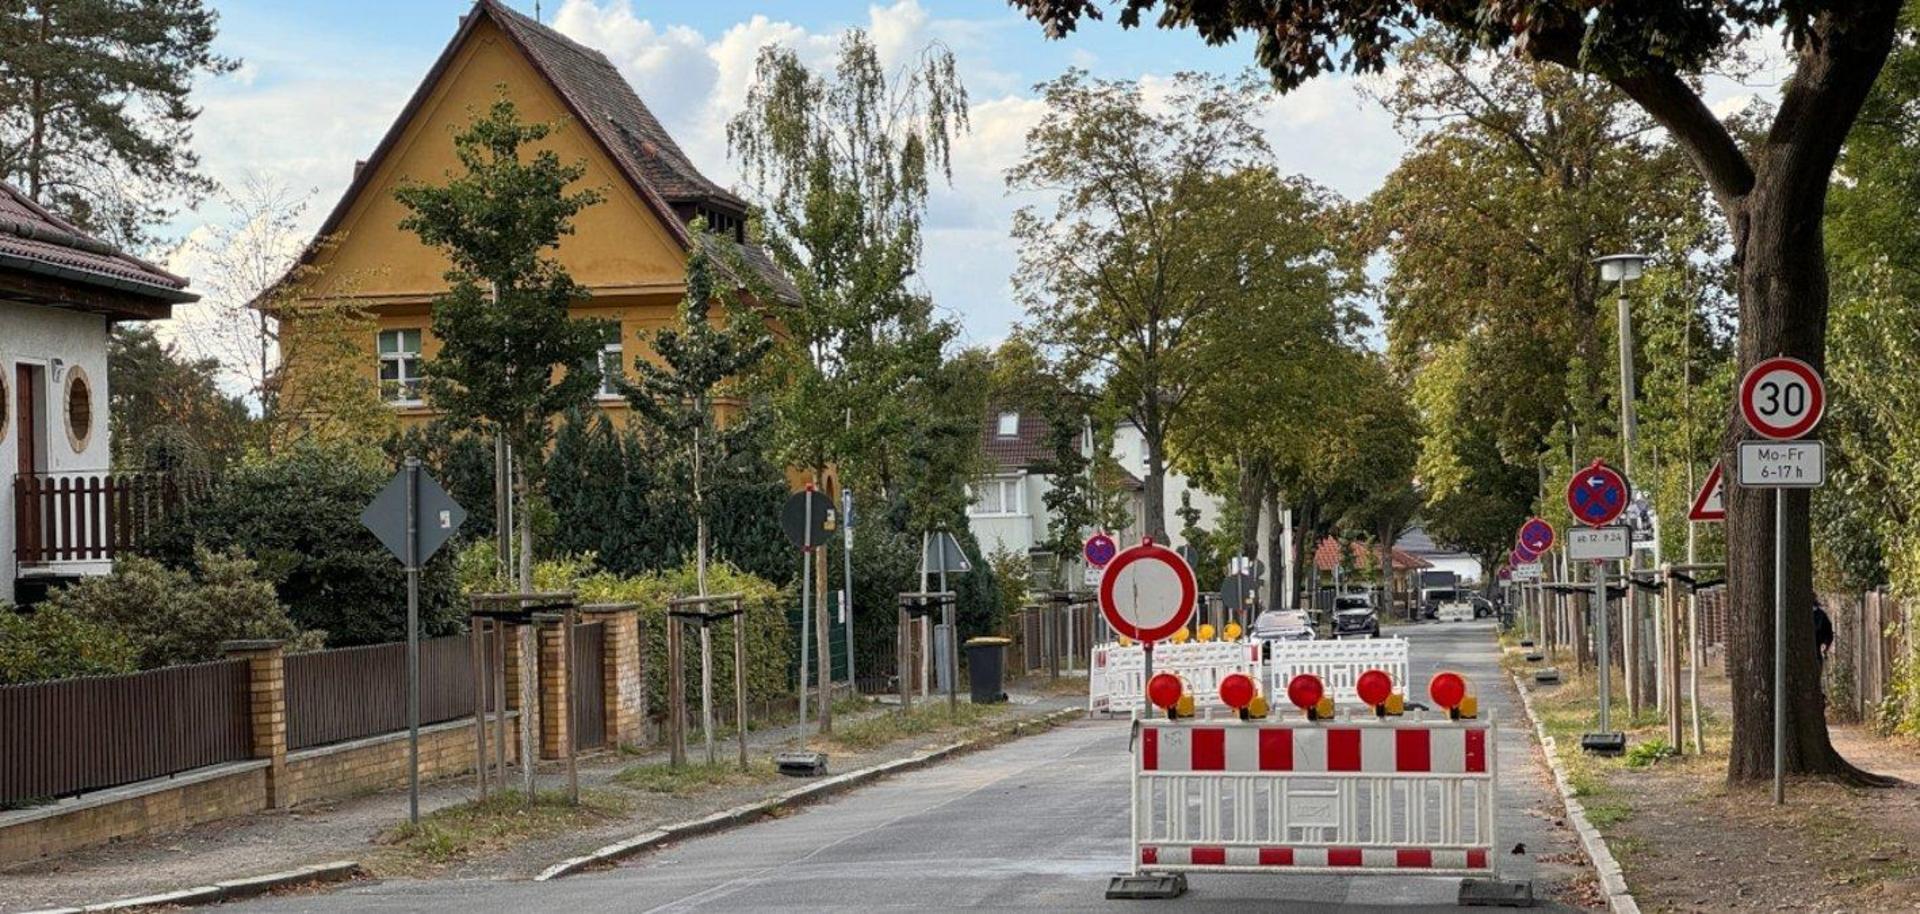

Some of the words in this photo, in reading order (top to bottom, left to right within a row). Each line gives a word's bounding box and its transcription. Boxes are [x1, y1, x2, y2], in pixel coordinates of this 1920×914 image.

[1759, 382, 1804, 416] 30
[1758, 448, 1804, 461] Mo-Fr
[1761, 465, 1791, 478] 6-17
[1796, 465, 1803, 478] h
